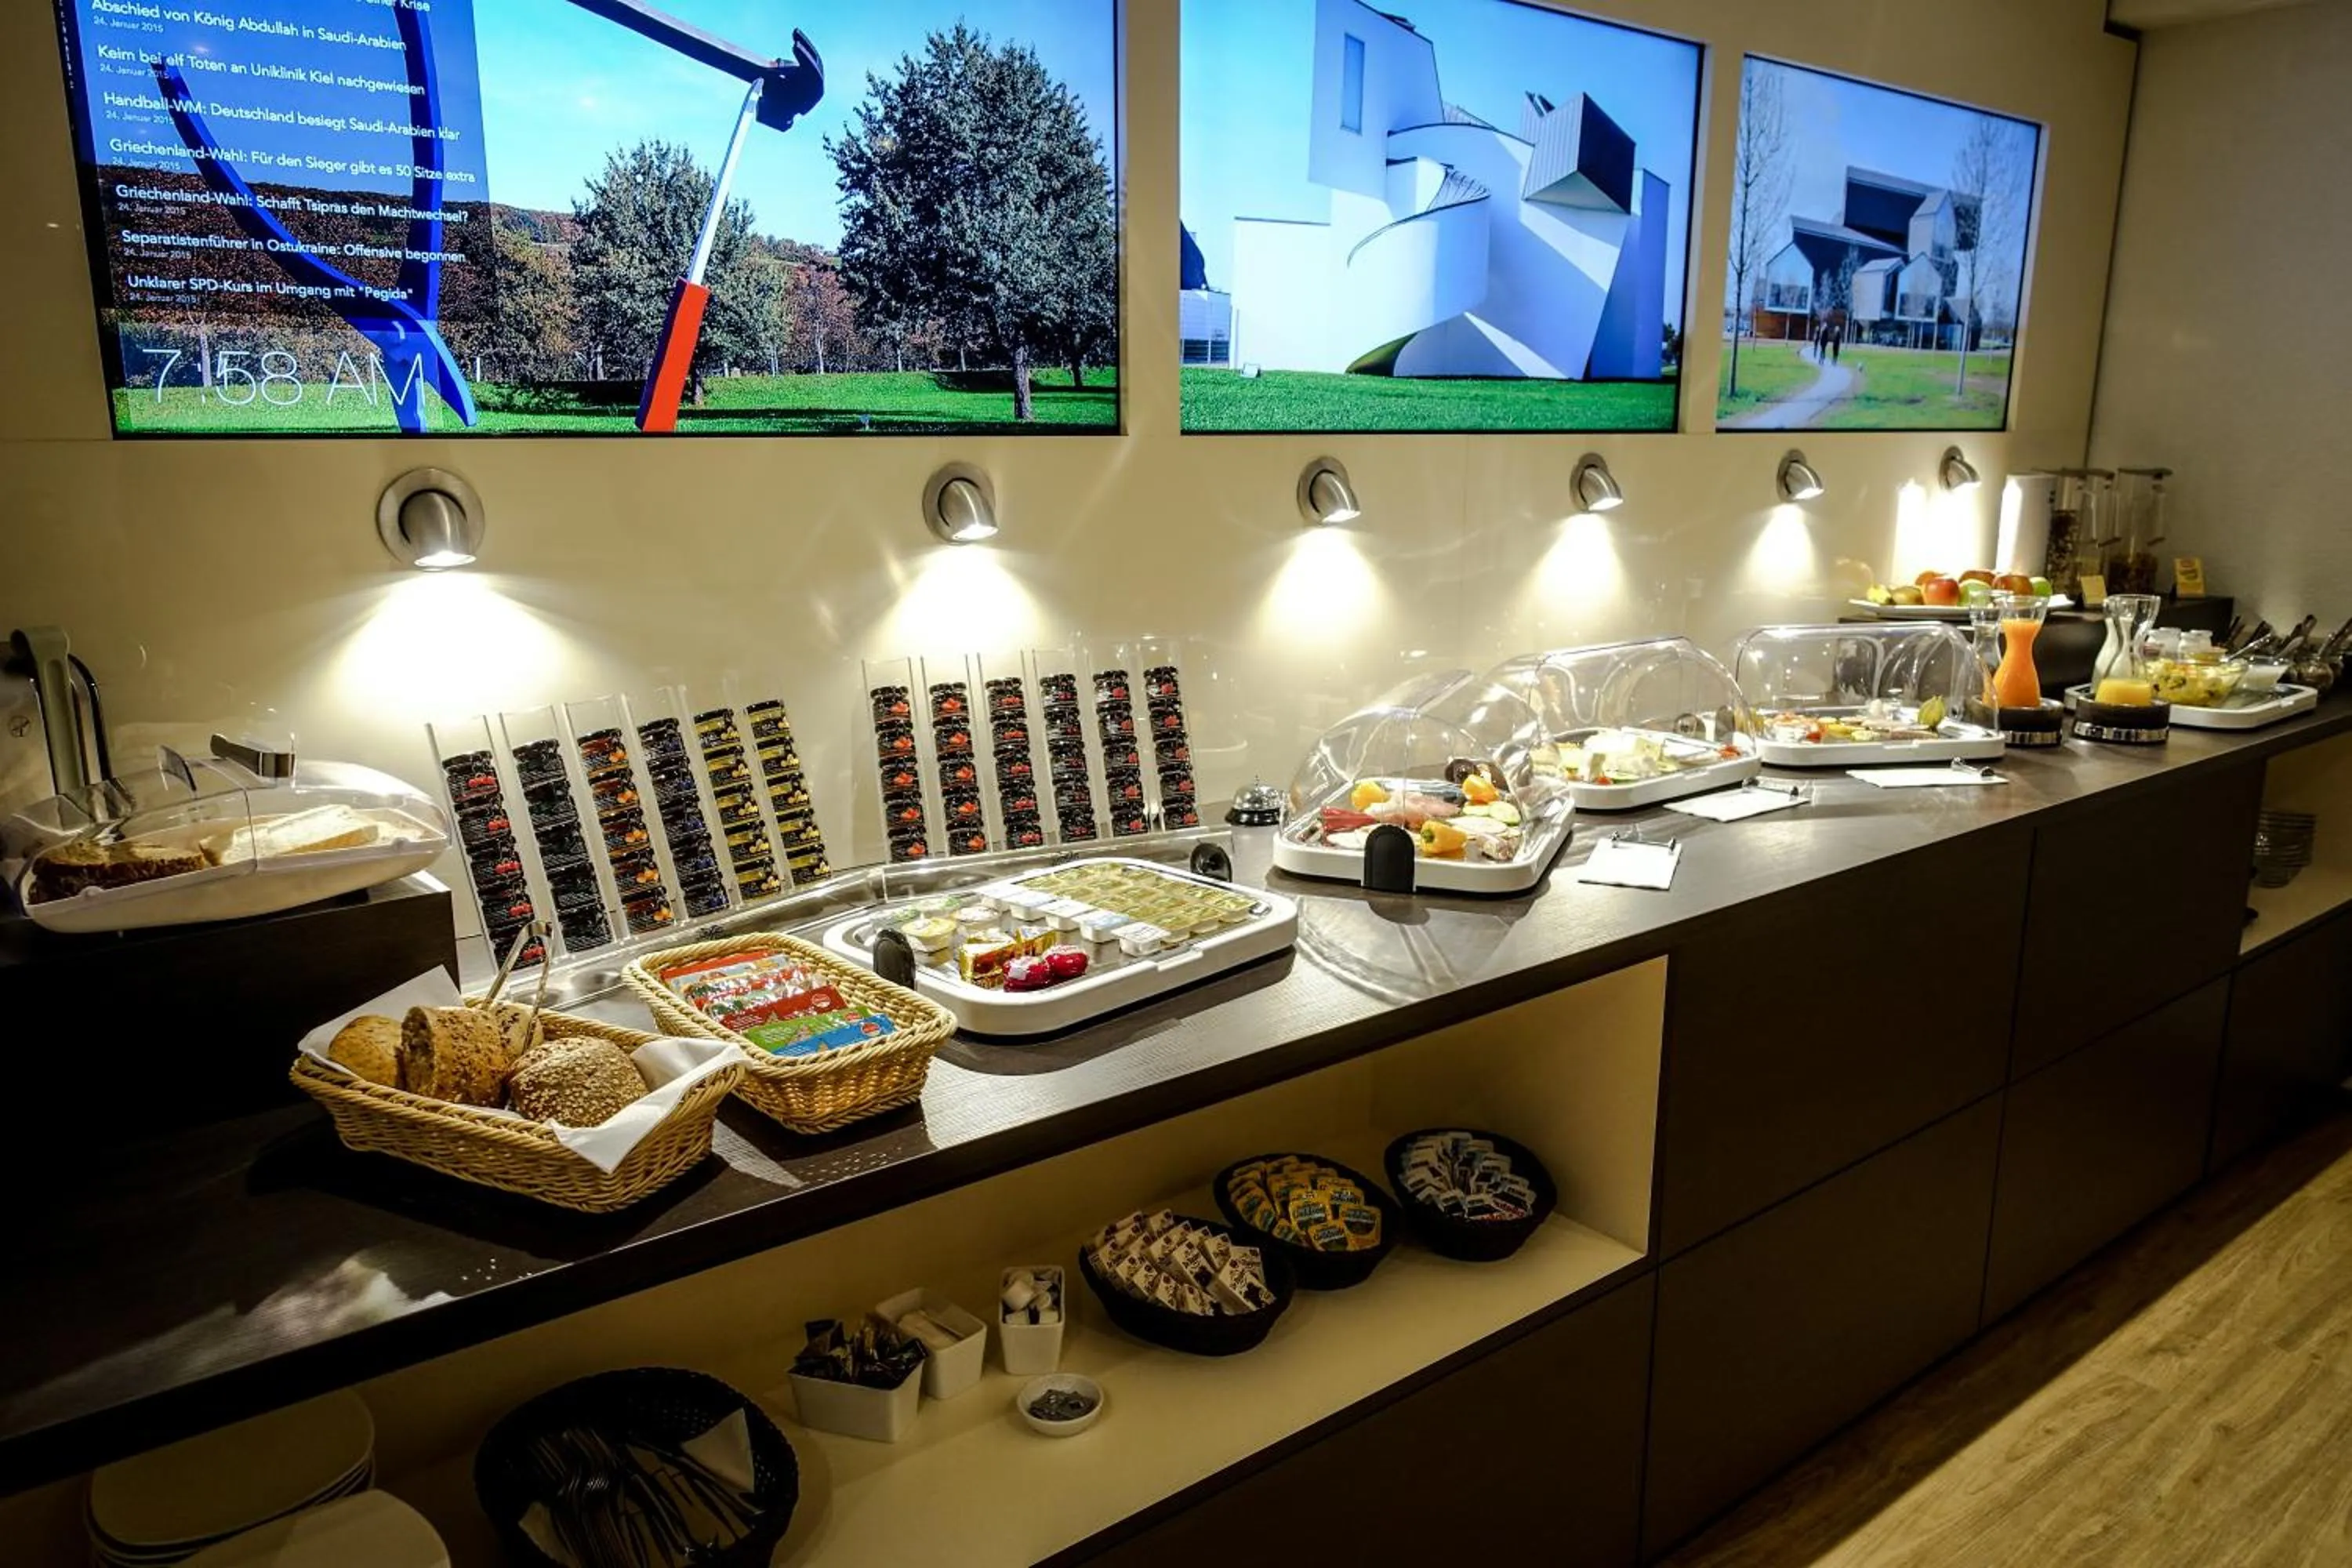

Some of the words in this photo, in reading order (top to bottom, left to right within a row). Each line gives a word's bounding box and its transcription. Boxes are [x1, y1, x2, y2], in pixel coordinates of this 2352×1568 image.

[92, 0, 160, 18] Abschied
[163, 9, 191, 23] von
[194, 10, 235, 31] König
[238, 16, 299, 37] Abdullah
[302, 26, 314, 38] in
[318, 27, 407, 51] Saudi-Arabien
[97, 44, 136, 62] Keim
[139, 48, 162, 65] bei
[165, 53, 185, 67] elf
[187, 55, 227, 72] Toten
[230, 64, 247, 74] an
[250, 62, 307, 82] Uniklinik
[310, 69, 335, 85] Kiel
[337, 76, 426, 96] nachgewiesen
[103, 91, 207, 115] Handball-WM:
[210, 103, 295, 124] Deutschland
[297, 111, 347, 132] besiegt
[349, 117, 436, 139] Saudi-Arabien
[438, 125, 461, 141] klar
[109, 138, 248, 163] Griechenland-Wahl:
[251, 151, 274, 165] Für
[277, 153, 303, 168] den
[305, 155, 347, 174] Sieger
[350, 159, 377, 176] gibt
[379, 165, 393, 176] es
[395, 164, 412, 177] 50
[414, 165, 444, 180] Sitze
[445, 170, 476, 183] extra
[115, 183, 253, 207] Griechenland-Wahl:
[256, 195, 303, 211] Schafft
[303, 198, 349, 216] Tsipras
[350, 201, 376, 216] den
[378, 205, 470, 223] Machtwechsel?
[122, 229, 249, 251] Separatistenführer
[251, 238, 263, 251] in
[267, 238, 342, 256] Ostukraine:
[343, 242, 402, 260] Offensive
[405, 247, 466, 263] begonnen
[126, 274, 186, 289] Unklarer
[189, 278, 253, 293] SPD-Kurs
[256, 281, 273, 294] im
[275, 282, 332, 300] Umgang
[334, 285, 356, 298] mit
[142, 348, 304, 405] 7:58
[325, 350, 427, 405] AM
